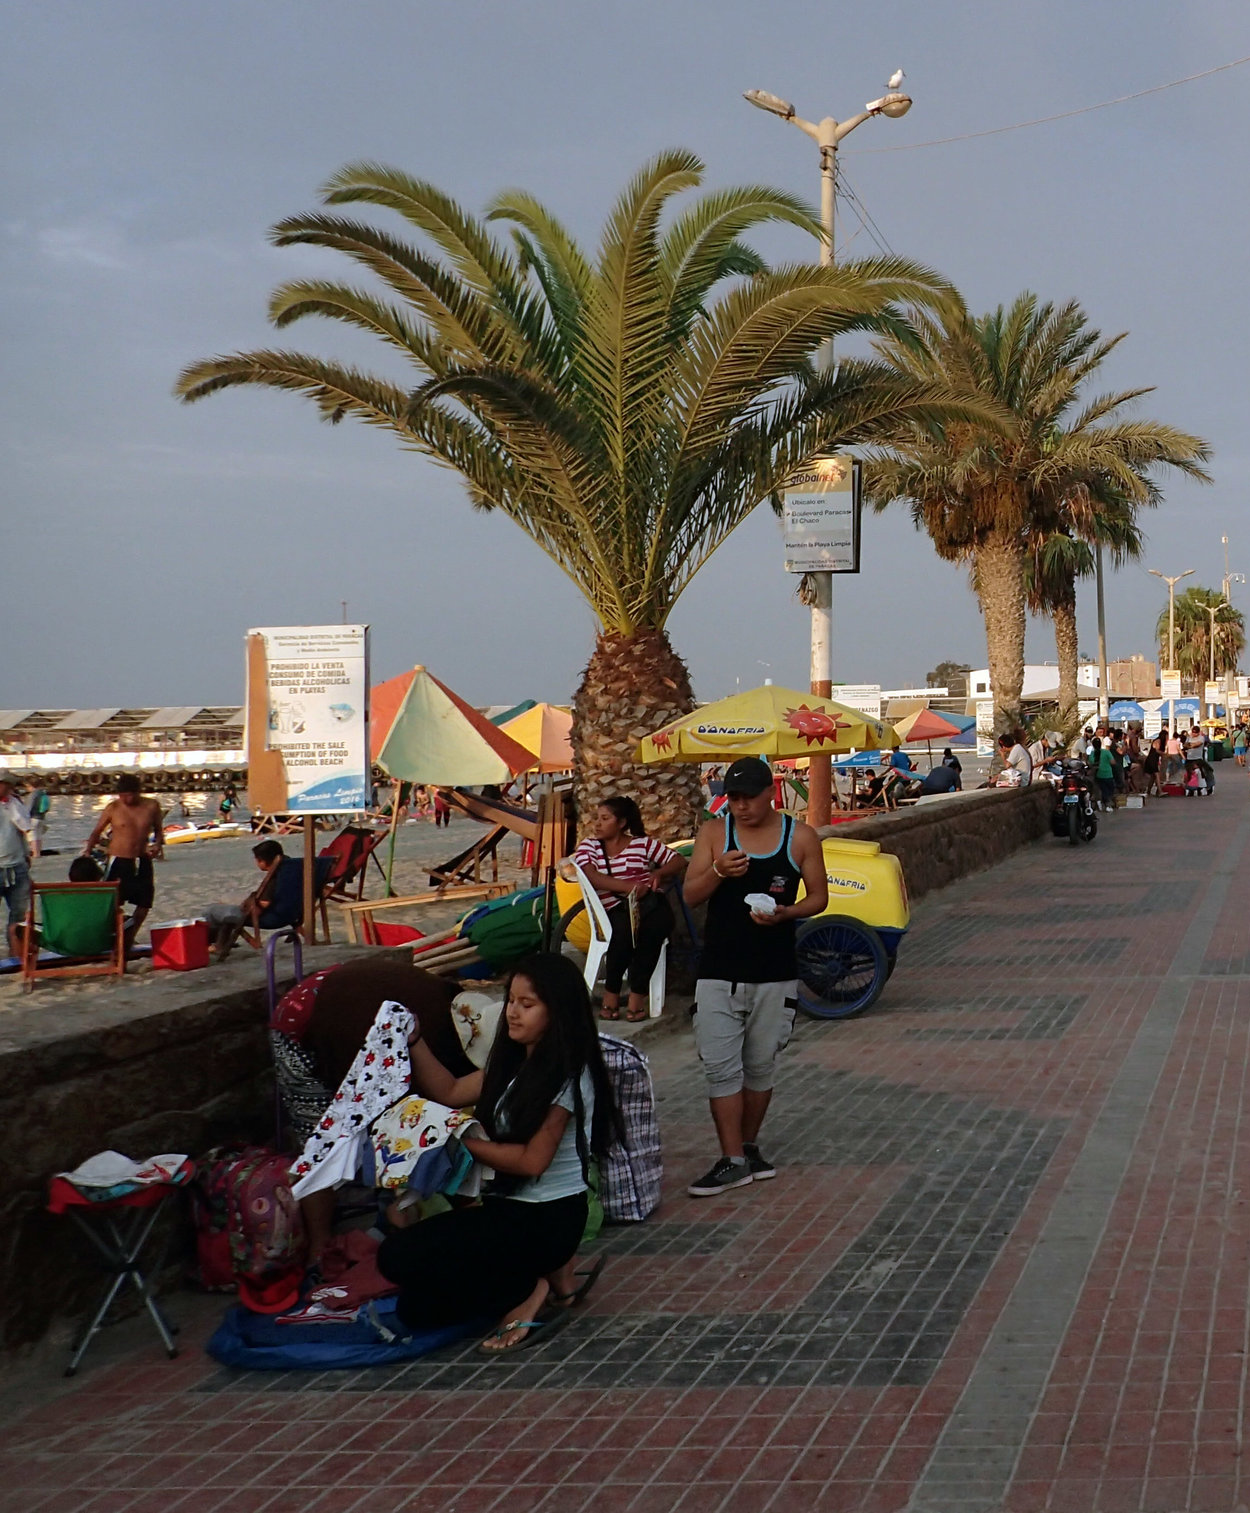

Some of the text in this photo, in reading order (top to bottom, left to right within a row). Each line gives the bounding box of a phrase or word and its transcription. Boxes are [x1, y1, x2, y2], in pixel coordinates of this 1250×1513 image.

[318, 669, 346, 677] COMIDA
[271, 678, 350, 687] BEBIDAS ALCOHOLICAS
[300, 686, 326, 694] PLAYAS
[320, 758, 344, 766] BEACH
